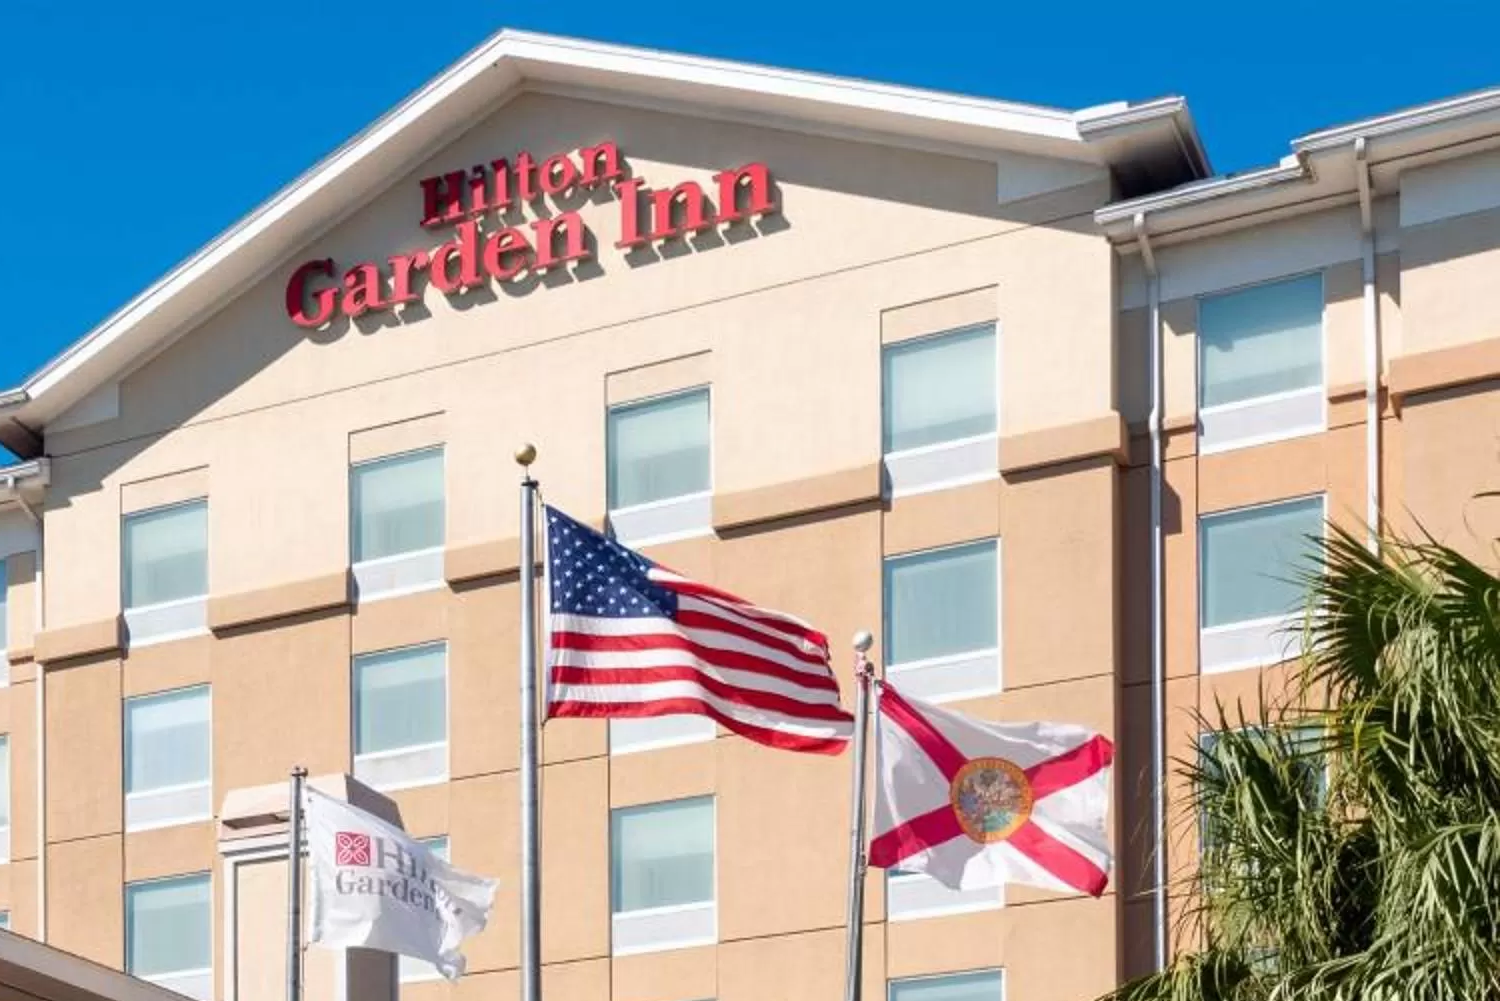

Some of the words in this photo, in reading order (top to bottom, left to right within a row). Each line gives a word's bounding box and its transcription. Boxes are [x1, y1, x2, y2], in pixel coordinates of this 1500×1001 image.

[285, 210, 589, 329] Garden
[613, 161, 774, 250] Inn
[419, 138, 623, 228] Hilton
